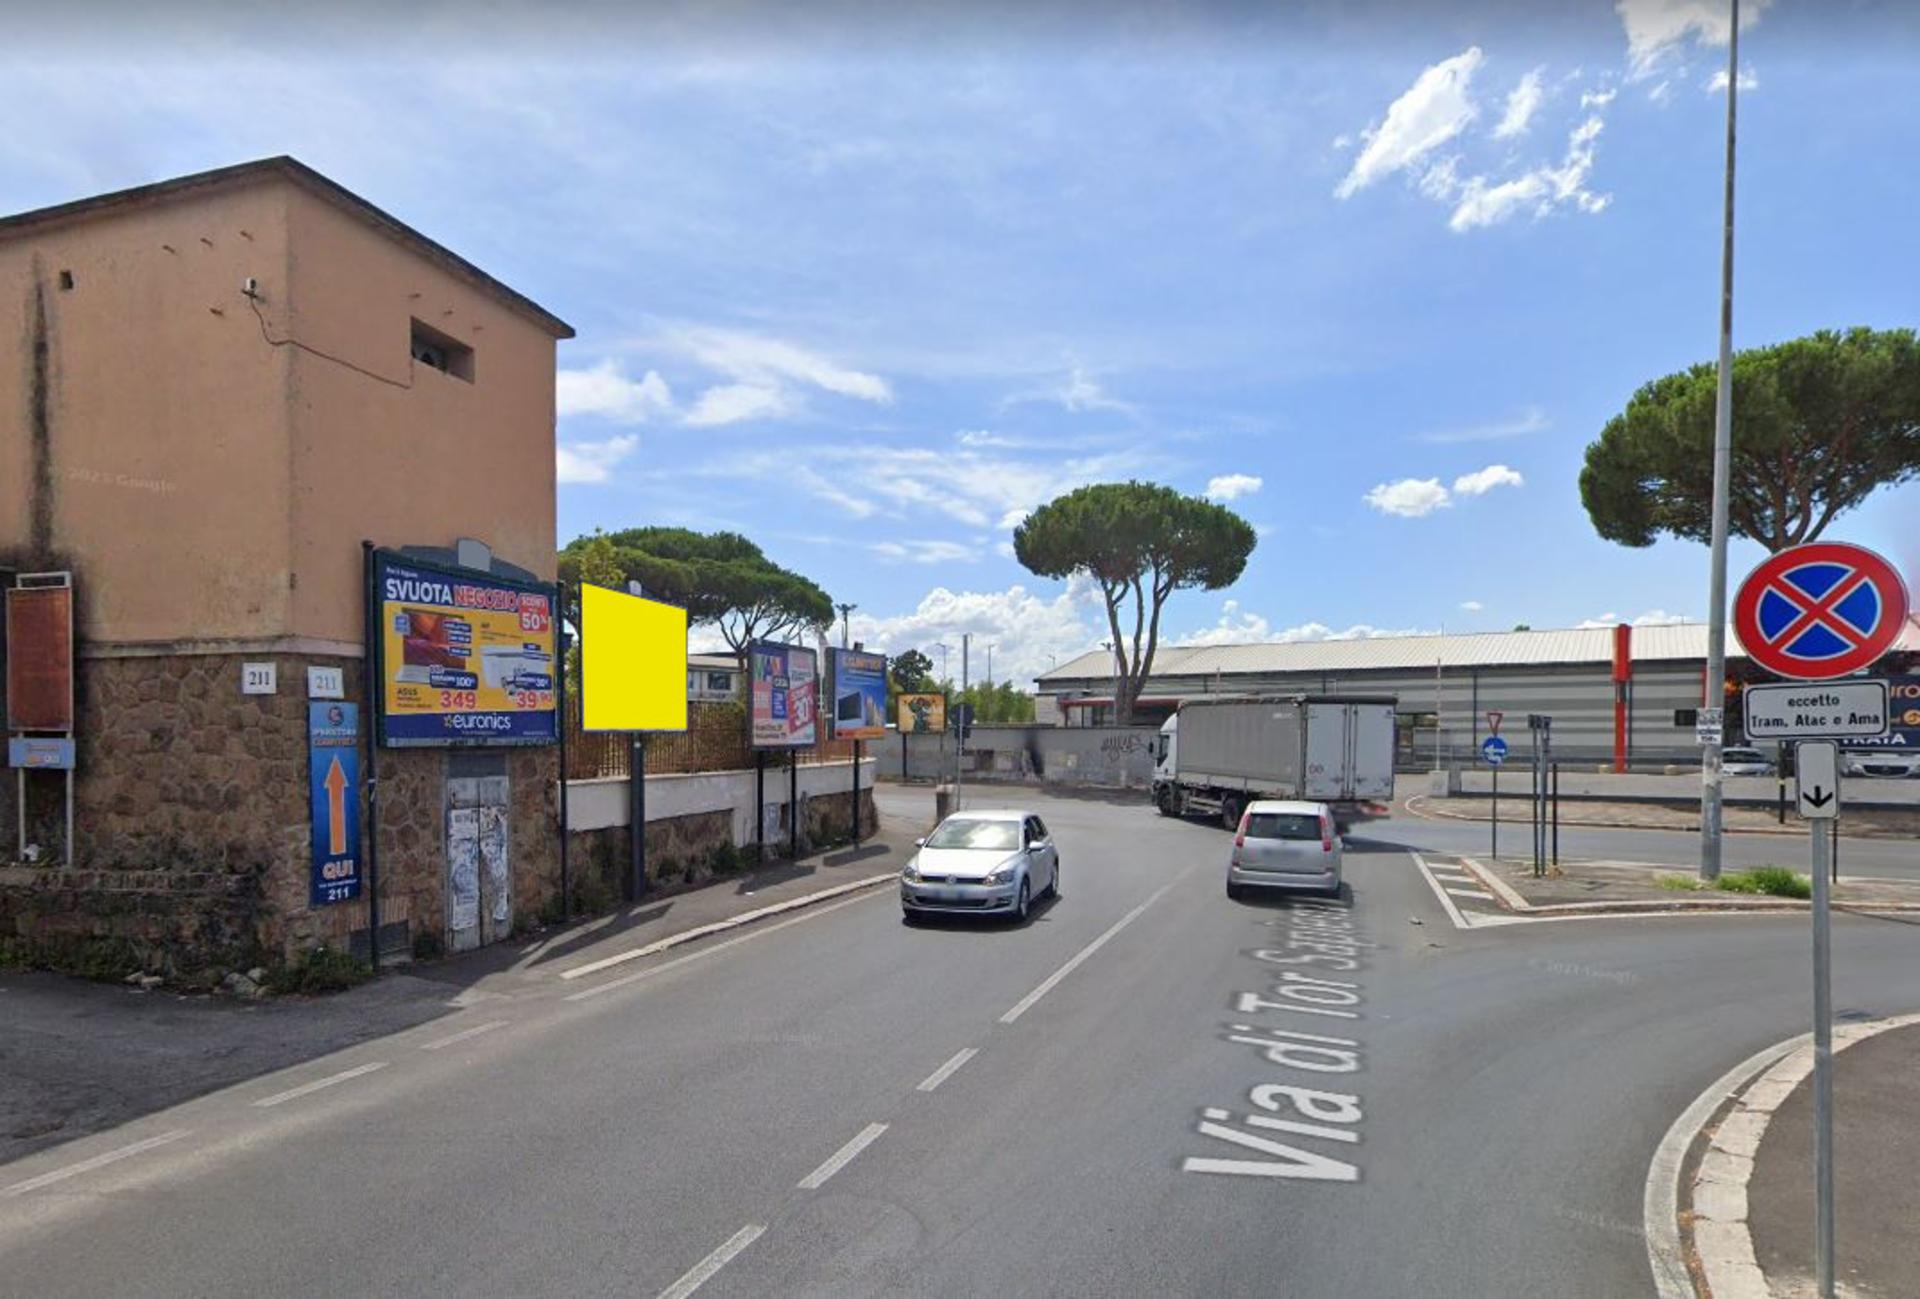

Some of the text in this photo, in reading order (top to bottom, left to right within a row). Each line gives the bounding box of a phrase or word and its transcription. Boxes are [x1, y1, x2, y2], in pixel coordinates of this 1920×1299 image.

[386, 578, 517, 610] SVUOTA NEGOZIO
[249, 671, 269, 686] 211
[315, 676, 336, 689] 211
[441, 691, 476, 709] 349
[1787, 694, 1840, 707] eccetto
[453, 713, 512, 730] euronics
[1795, 713, 1826, 727] Atac
[1833, 716, 1842, 726] e
[1848, 712, 1880, 725] Ama
[322, 859, 354, 880] QUI
[328, 886, 350, 900] 211
